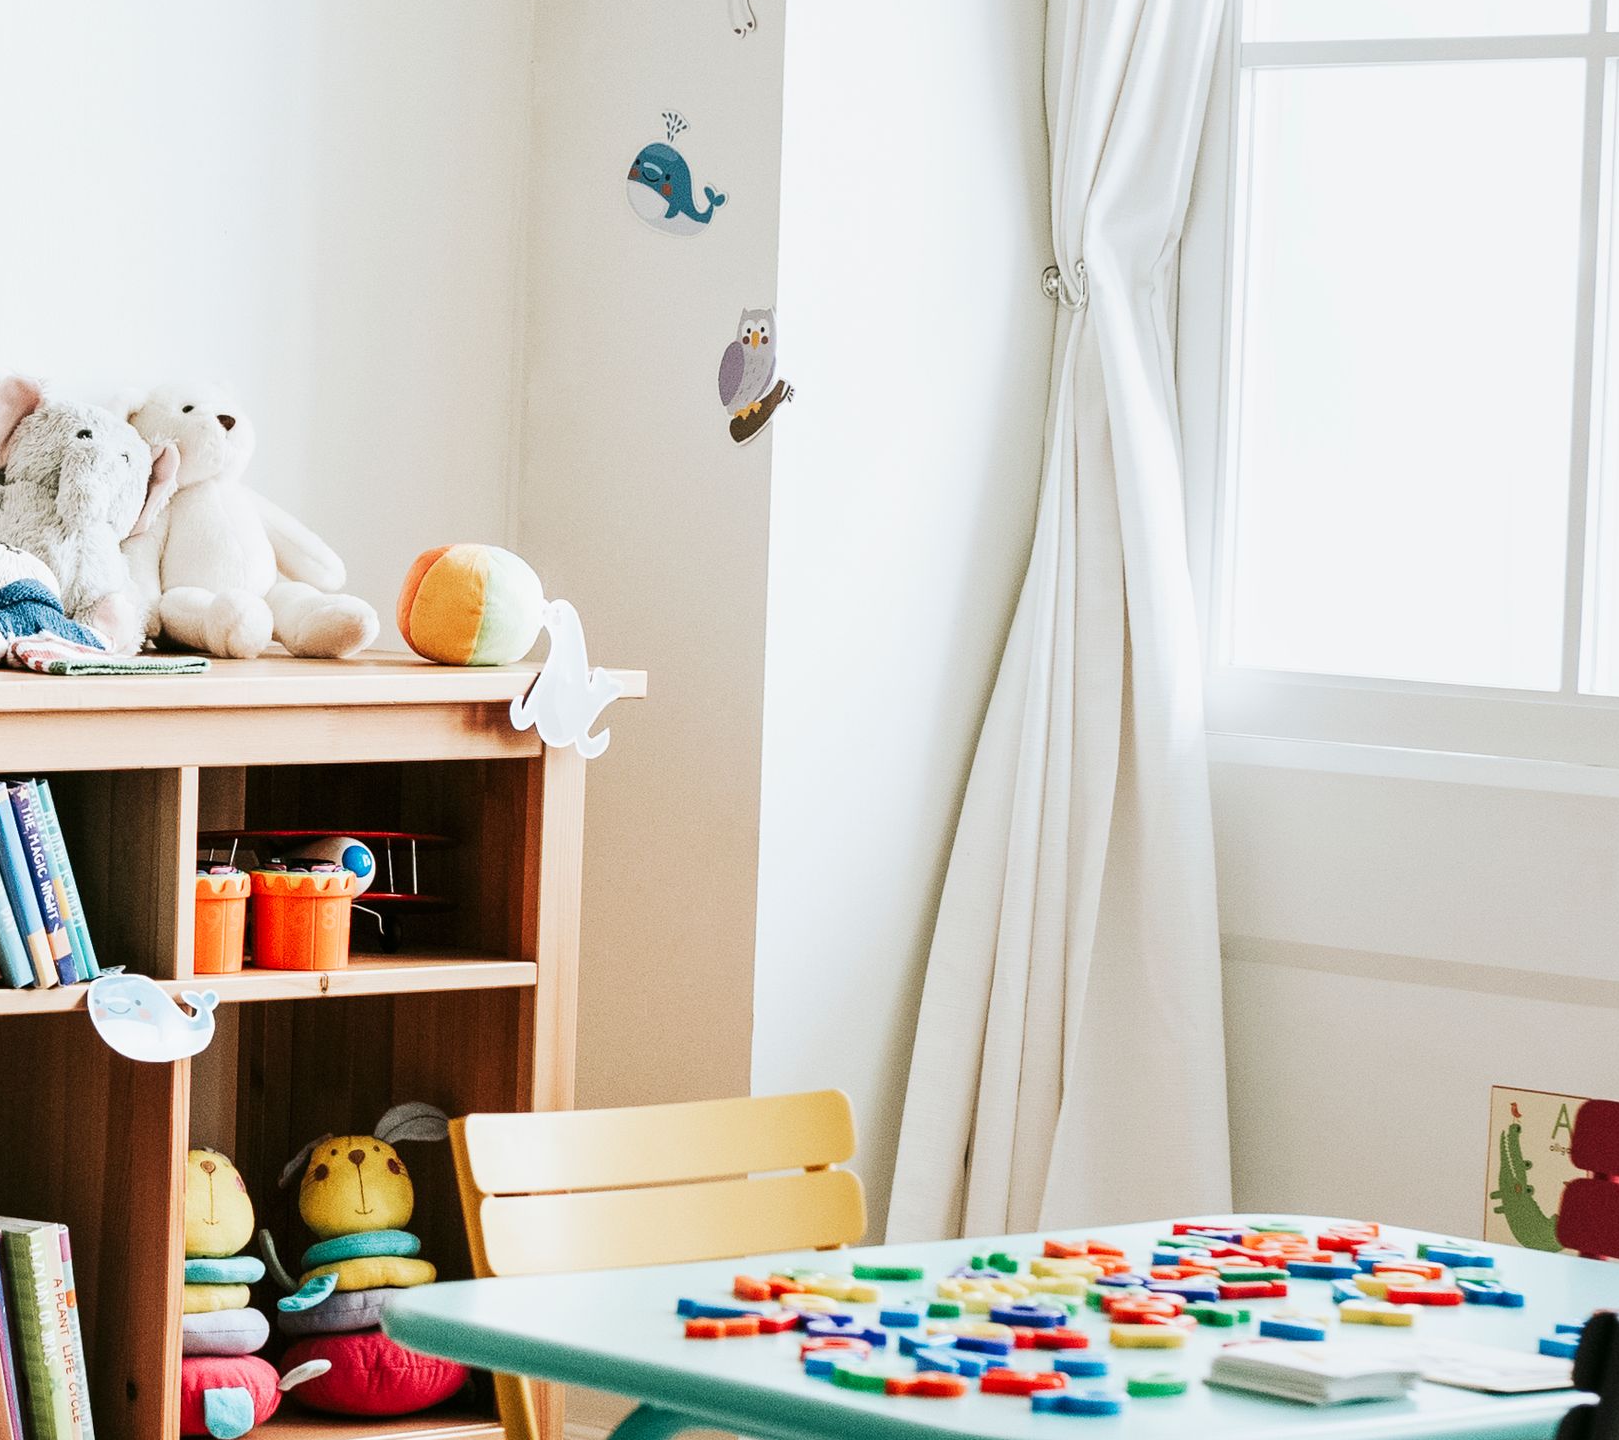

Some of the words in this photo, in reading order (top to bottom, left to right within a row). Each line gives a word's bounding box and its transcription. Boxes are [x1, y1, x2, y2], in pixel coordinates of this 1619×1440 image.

[21, 803, 36, 831] THE
[29, 834, 48, 878] MAGIC
[40, 881, 60, 920] NIGHT
[1552, 1103, 1572, 1140] A
[53, 1277, 63, 1288] A
[55, 1292, 70, 1335] PLANT
[62, 1344, 75, 1375] LIFE
[68, 1383, 81, 1423] CYCLE
